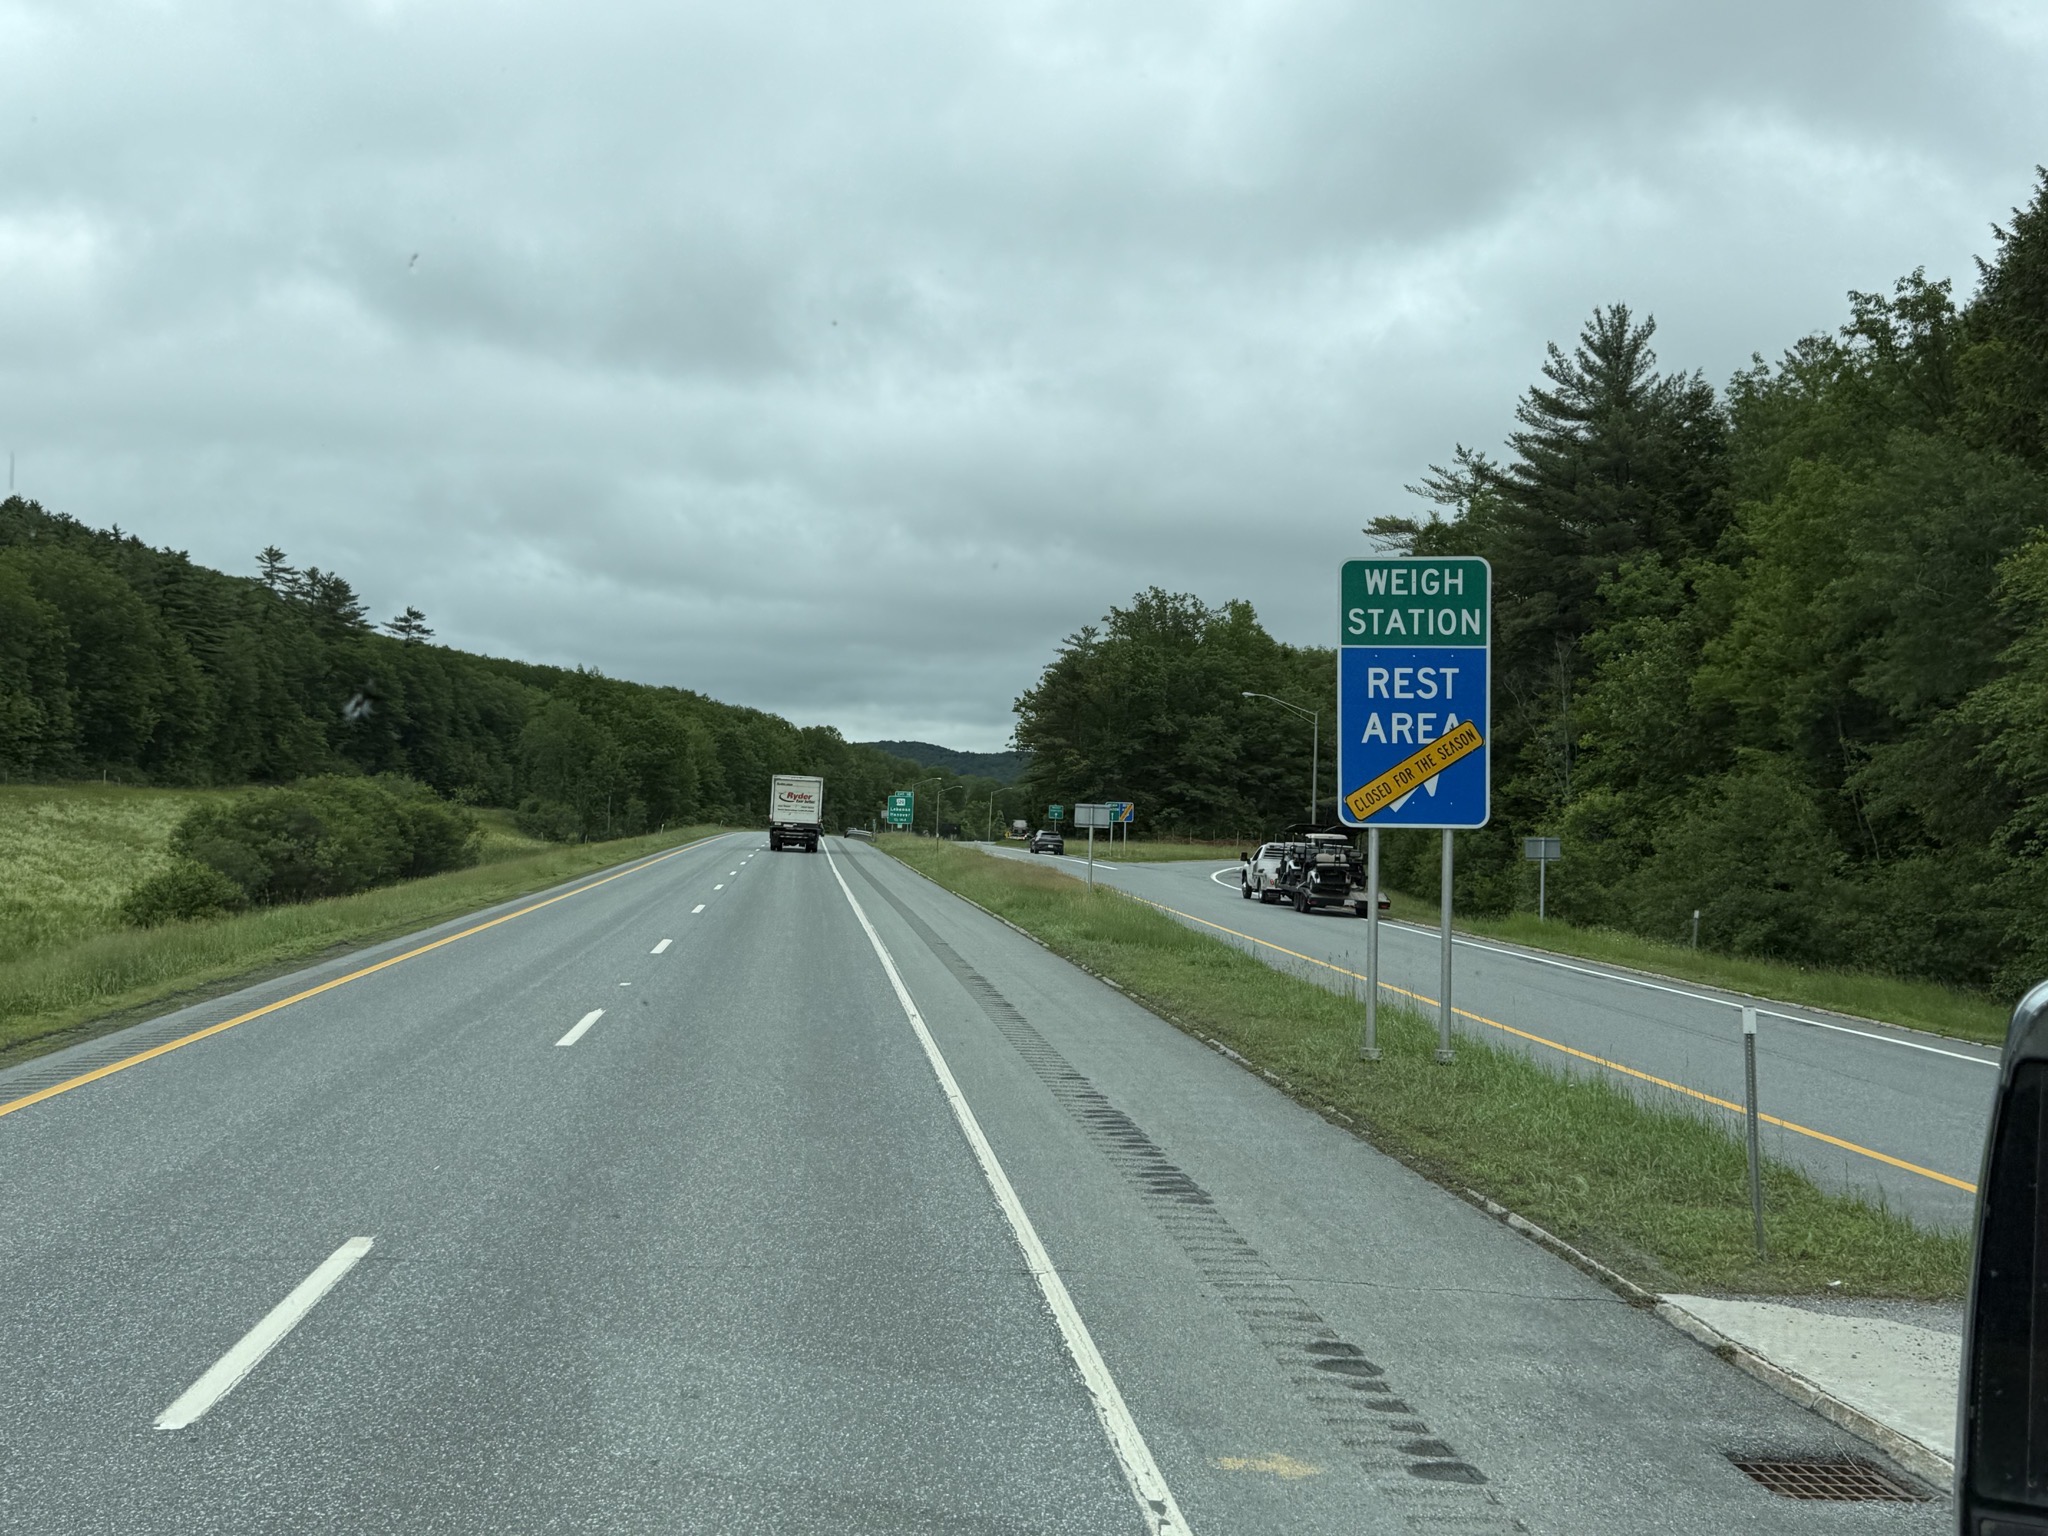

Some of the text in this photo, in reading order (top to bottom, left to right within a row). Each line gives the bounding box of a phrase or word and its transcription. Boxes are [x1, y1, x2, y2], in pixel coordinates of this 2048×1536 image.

[1364, 568, 1464, 596] WEIGH
[1347, 608, 1481, 636] STATION
[1367, 667, 1460, 700] REST
[1353, 729, 1477, 812] CLOSED FOR THE SEASON
[786, 791, 813, 800] Ryder
